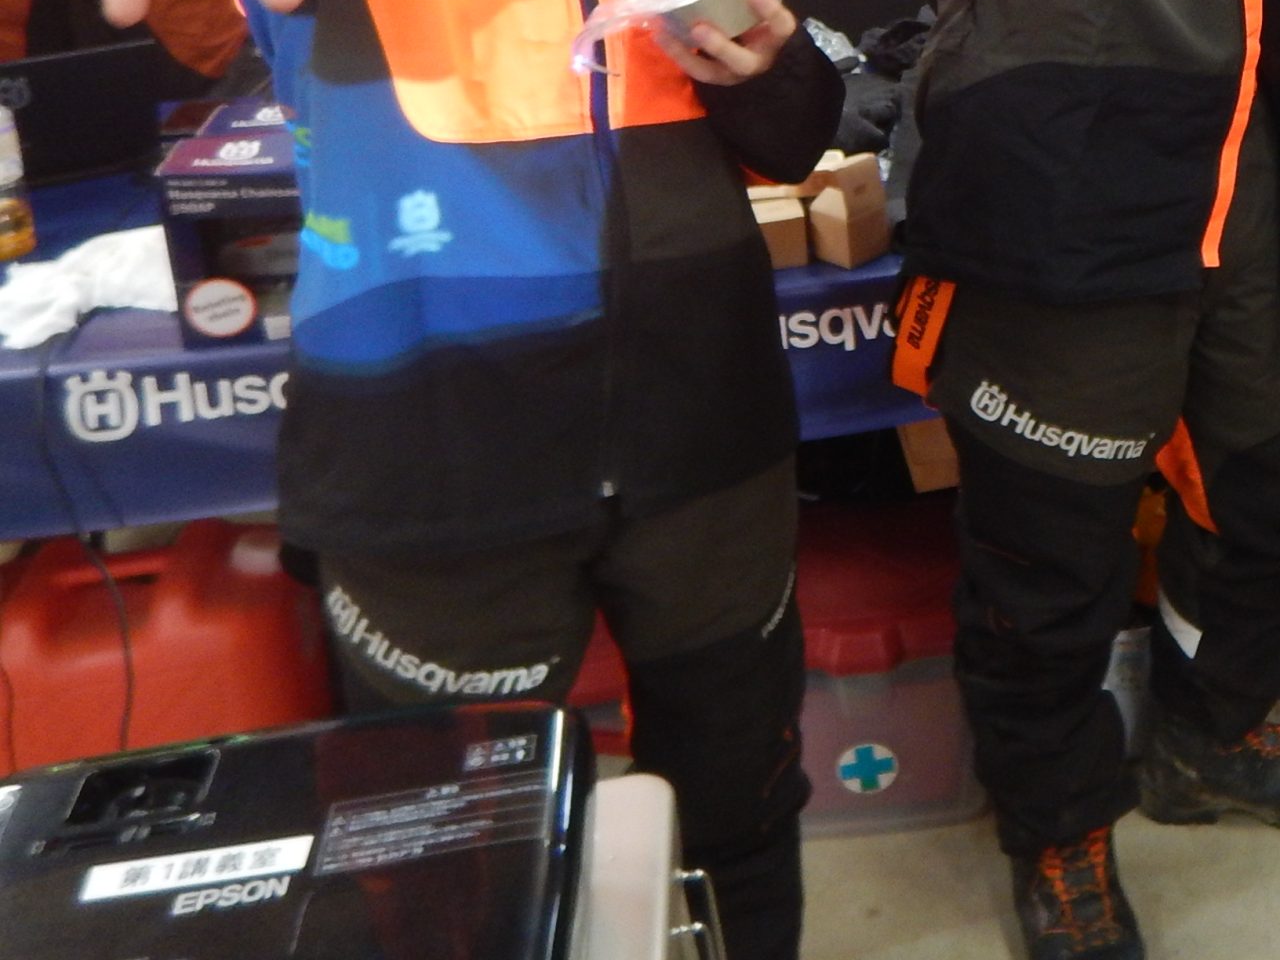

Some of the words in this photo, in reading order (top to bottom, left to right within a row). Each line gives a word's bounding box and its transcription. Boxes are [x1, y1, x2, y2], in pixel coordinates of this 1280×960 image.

[1000, 403, 1148, 460] Husqvarna
[351, 617, 550, 695] Husqvarna
[172, 876, 292, 917] EPSON
